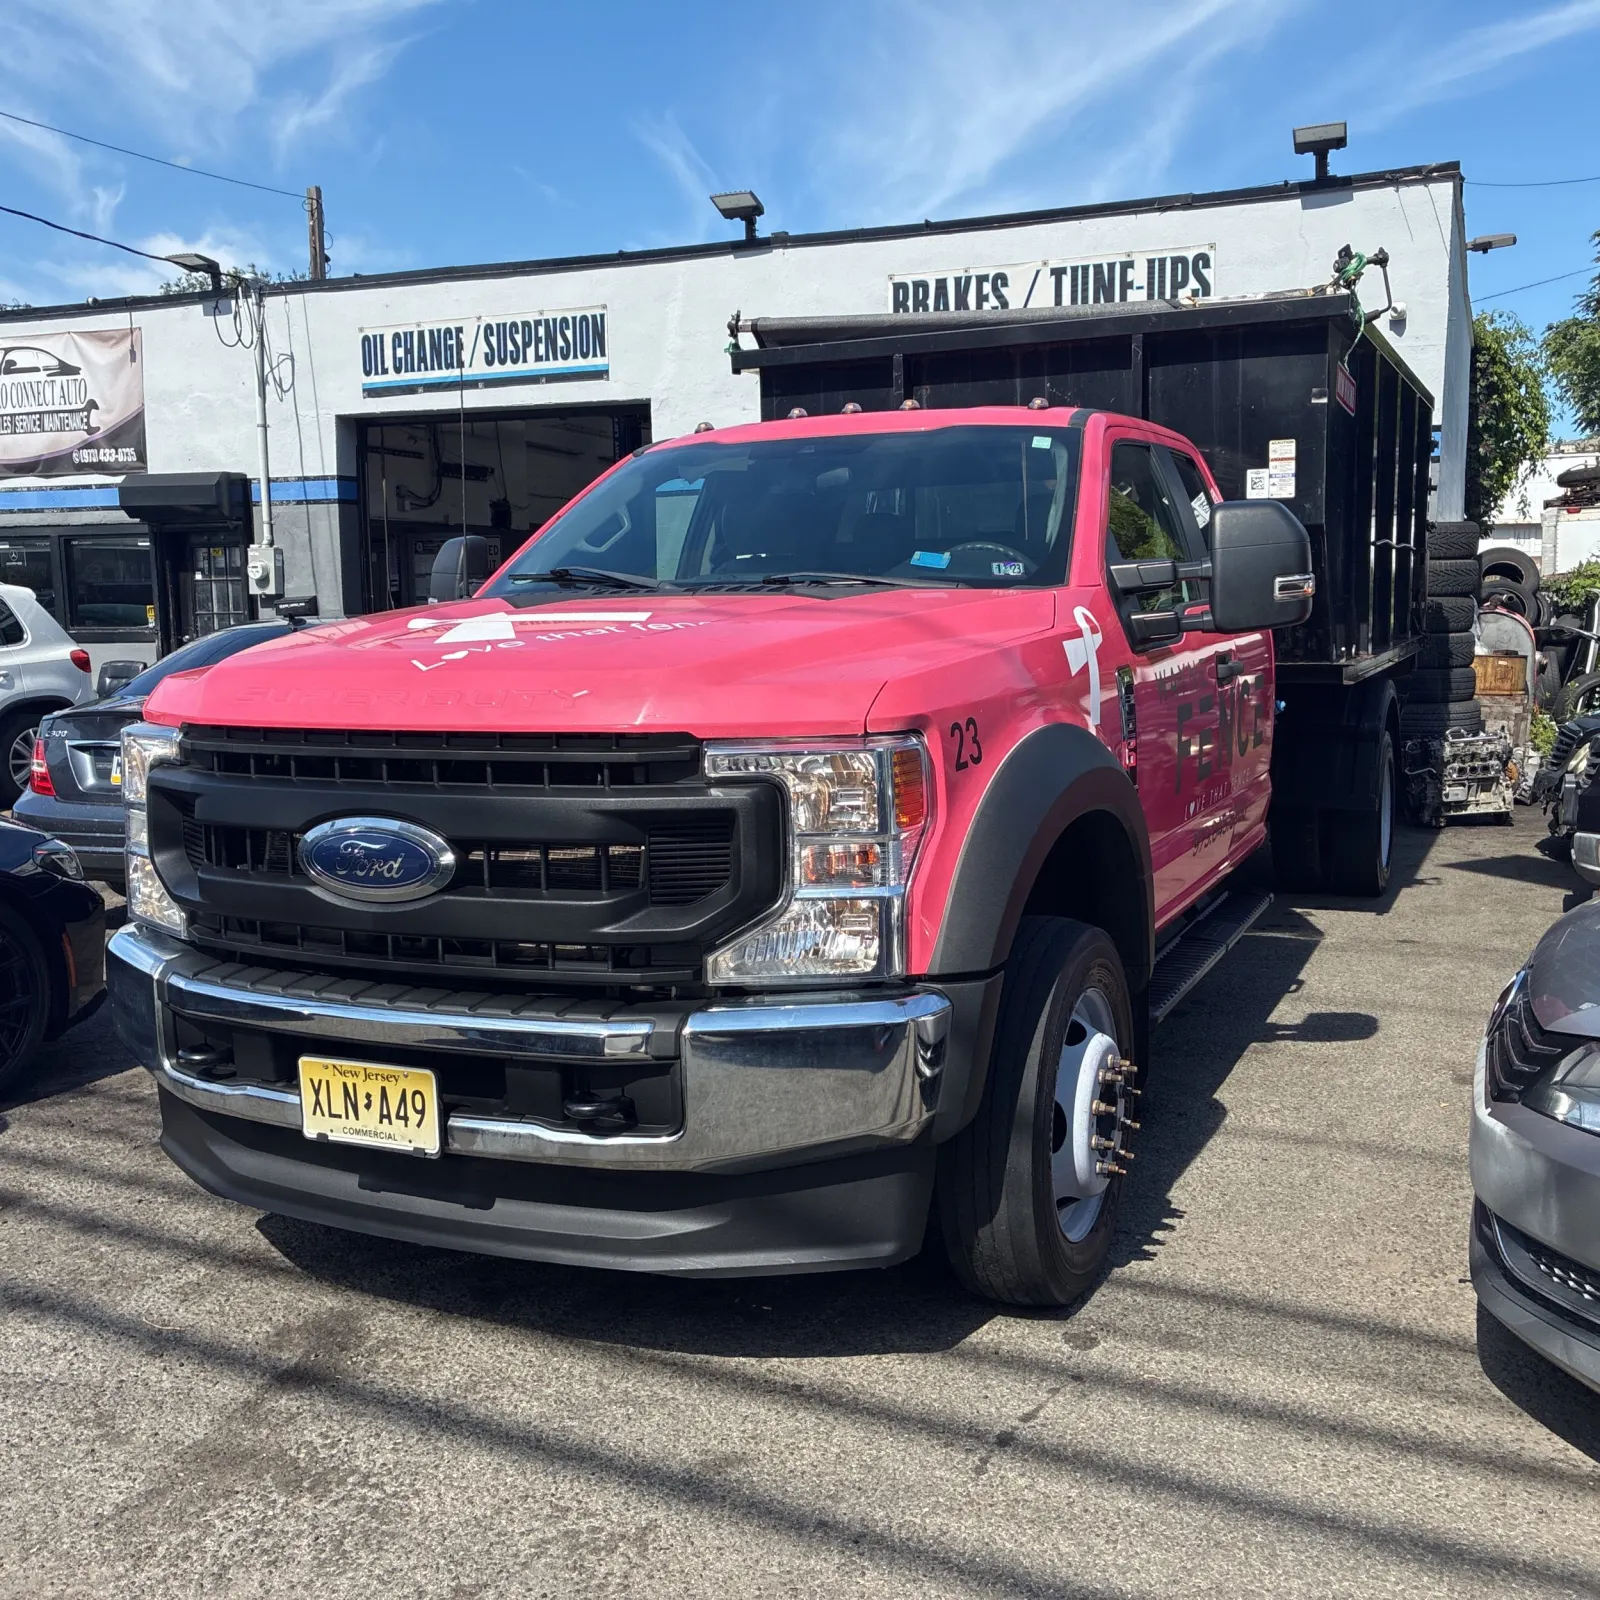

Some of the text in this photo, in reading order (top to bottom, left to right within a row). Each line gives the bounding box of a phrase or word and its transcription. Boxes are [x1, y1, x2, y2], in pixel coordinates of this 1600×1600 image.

[893, 272, 1010, 313] BRAKES
[1050, 252, 1211, 306] TUNE-UPS
[361, 334, 389, 377] OIL
[391, 326, 465, 375] CHANGE
[483, 313, 606, 367] SUSPENSION
[10, 380, 56, 408] CONNECT
[60, 378, 88, 406] AUTO
[0, 415, 11, 433] LES
[15, 414, 40, 432] SERVICE
[44, 412, 88, 431] MAINTENANCE
[80, 448, 137, 463] (973) 433-0735
[536, 624, 625, 642] that
[234, 686, 595, 709] SUPER DUTY
[950, 717, 982, 772] 23
[1209, 781, 1228, 806] THAT
[335, 839, 405, 879] Ford
[332, 1064, 401, 1086] New Jersey
[309, 1077, 426, 1129] XLN A49
[342, 1126, 398, 1142] COMMERCIAL
